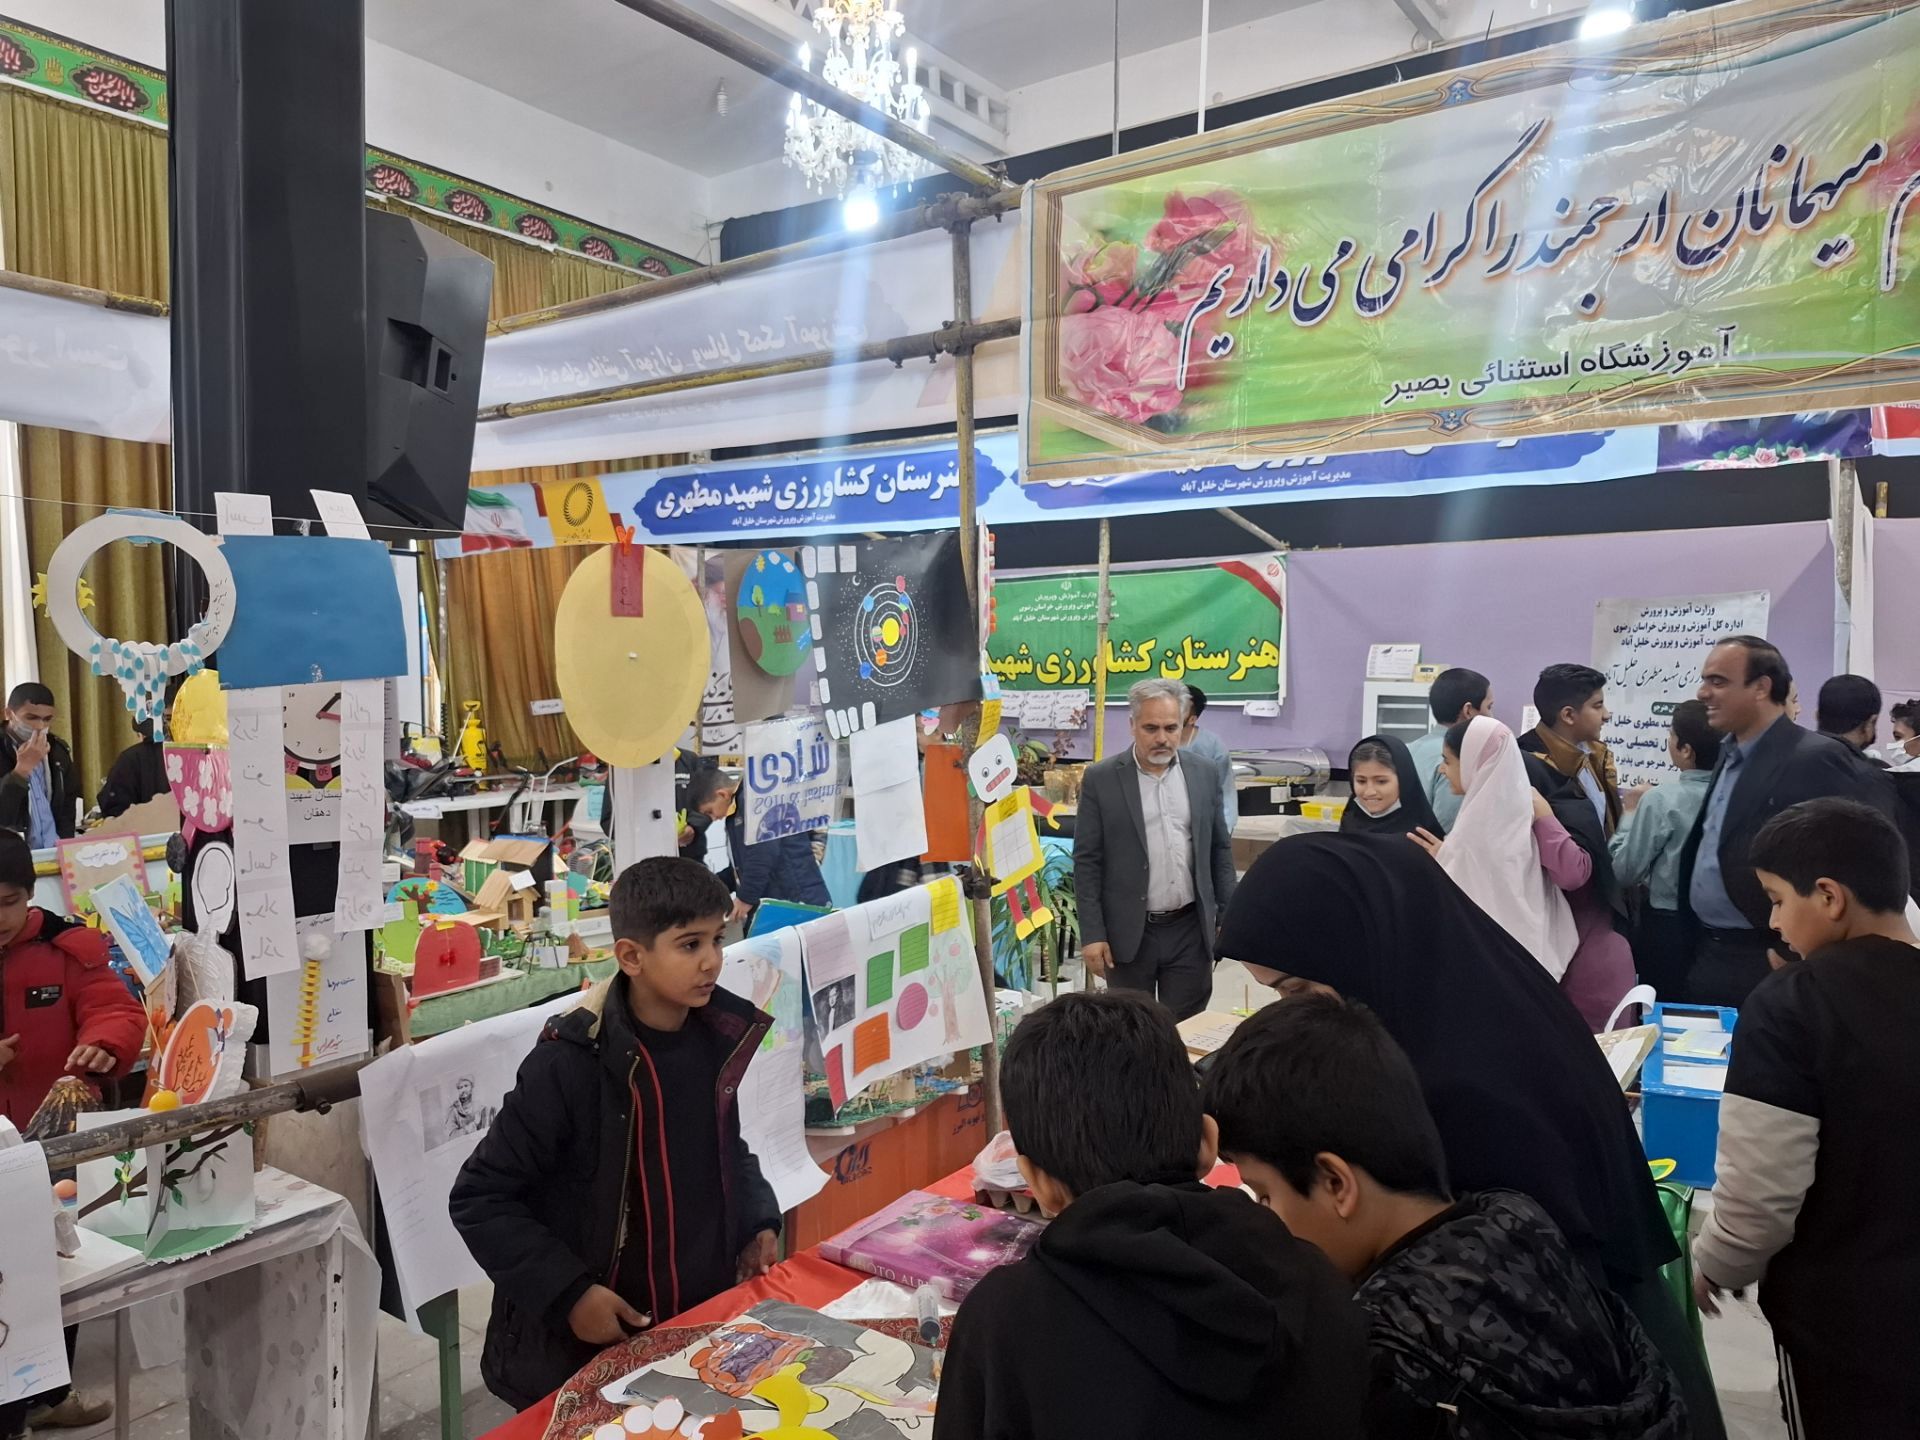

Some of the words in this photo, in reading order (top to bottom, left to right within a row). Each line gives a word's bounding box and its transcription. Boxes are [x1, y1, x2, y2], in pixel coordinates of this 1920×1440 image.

[1291, 239, 1354, 326] می
[1579, 325, 1737, 375] آموزشگاه
[1461, 351, 1570, 396] استثنائی
[1385, 371, 1452, 404] بصیر
[875, 460, 960, 503] نرستان
[1286, 470, 1318, 487] آموزش
[1318, 470, 1352, 483] مدیریت
[775, 463, 876, 510] کشاورزی
[1181, 480, 1197, 492] آباد
[1197, 480, 1217, 492] خلیل
[1217, 477, 1252, 491] شهرستان
[655, 479, 722, 518] مطهری
[724, 474, 774, 511] شهید
[1640, 607, 1663, 618] پرورش
[1669, 603, 1692, 618] آموزش
[1694, 605, 1715, 615] وزارت
[1613, 624, 1632, 633] رضوی
[1632, 623, 1657, 633] خراسان
[1658, 622, 1681, 633] پرورش
[1687, 618, 1711, 632] آموزش
[1712, 620, 1724, 631] کل
[1725, 619, 1744, 632] اداره
[1621, 635, 1633, 647] آباد
[1634, 638, 1650, 652] خلیل
[1651, 639, 1674, 649] پرورش
[1680, 634, 1705, 648] آموزش
[1160, 637, 1280, 681] هنرستان
[1614, 715, 1632, 728] خلیل
[1634, 717, 1660, 729] مطهری
[1627, 736, 1659, 749] تحصیلی
[748, 732, 829, 794] شادی
[1646, 759, 1666, 769] هنرجو
[315, 790, 342, 801] بستان
[304, 807, 331, 821] دهقان
[849, 1254, 896, 1281] PHOTO
